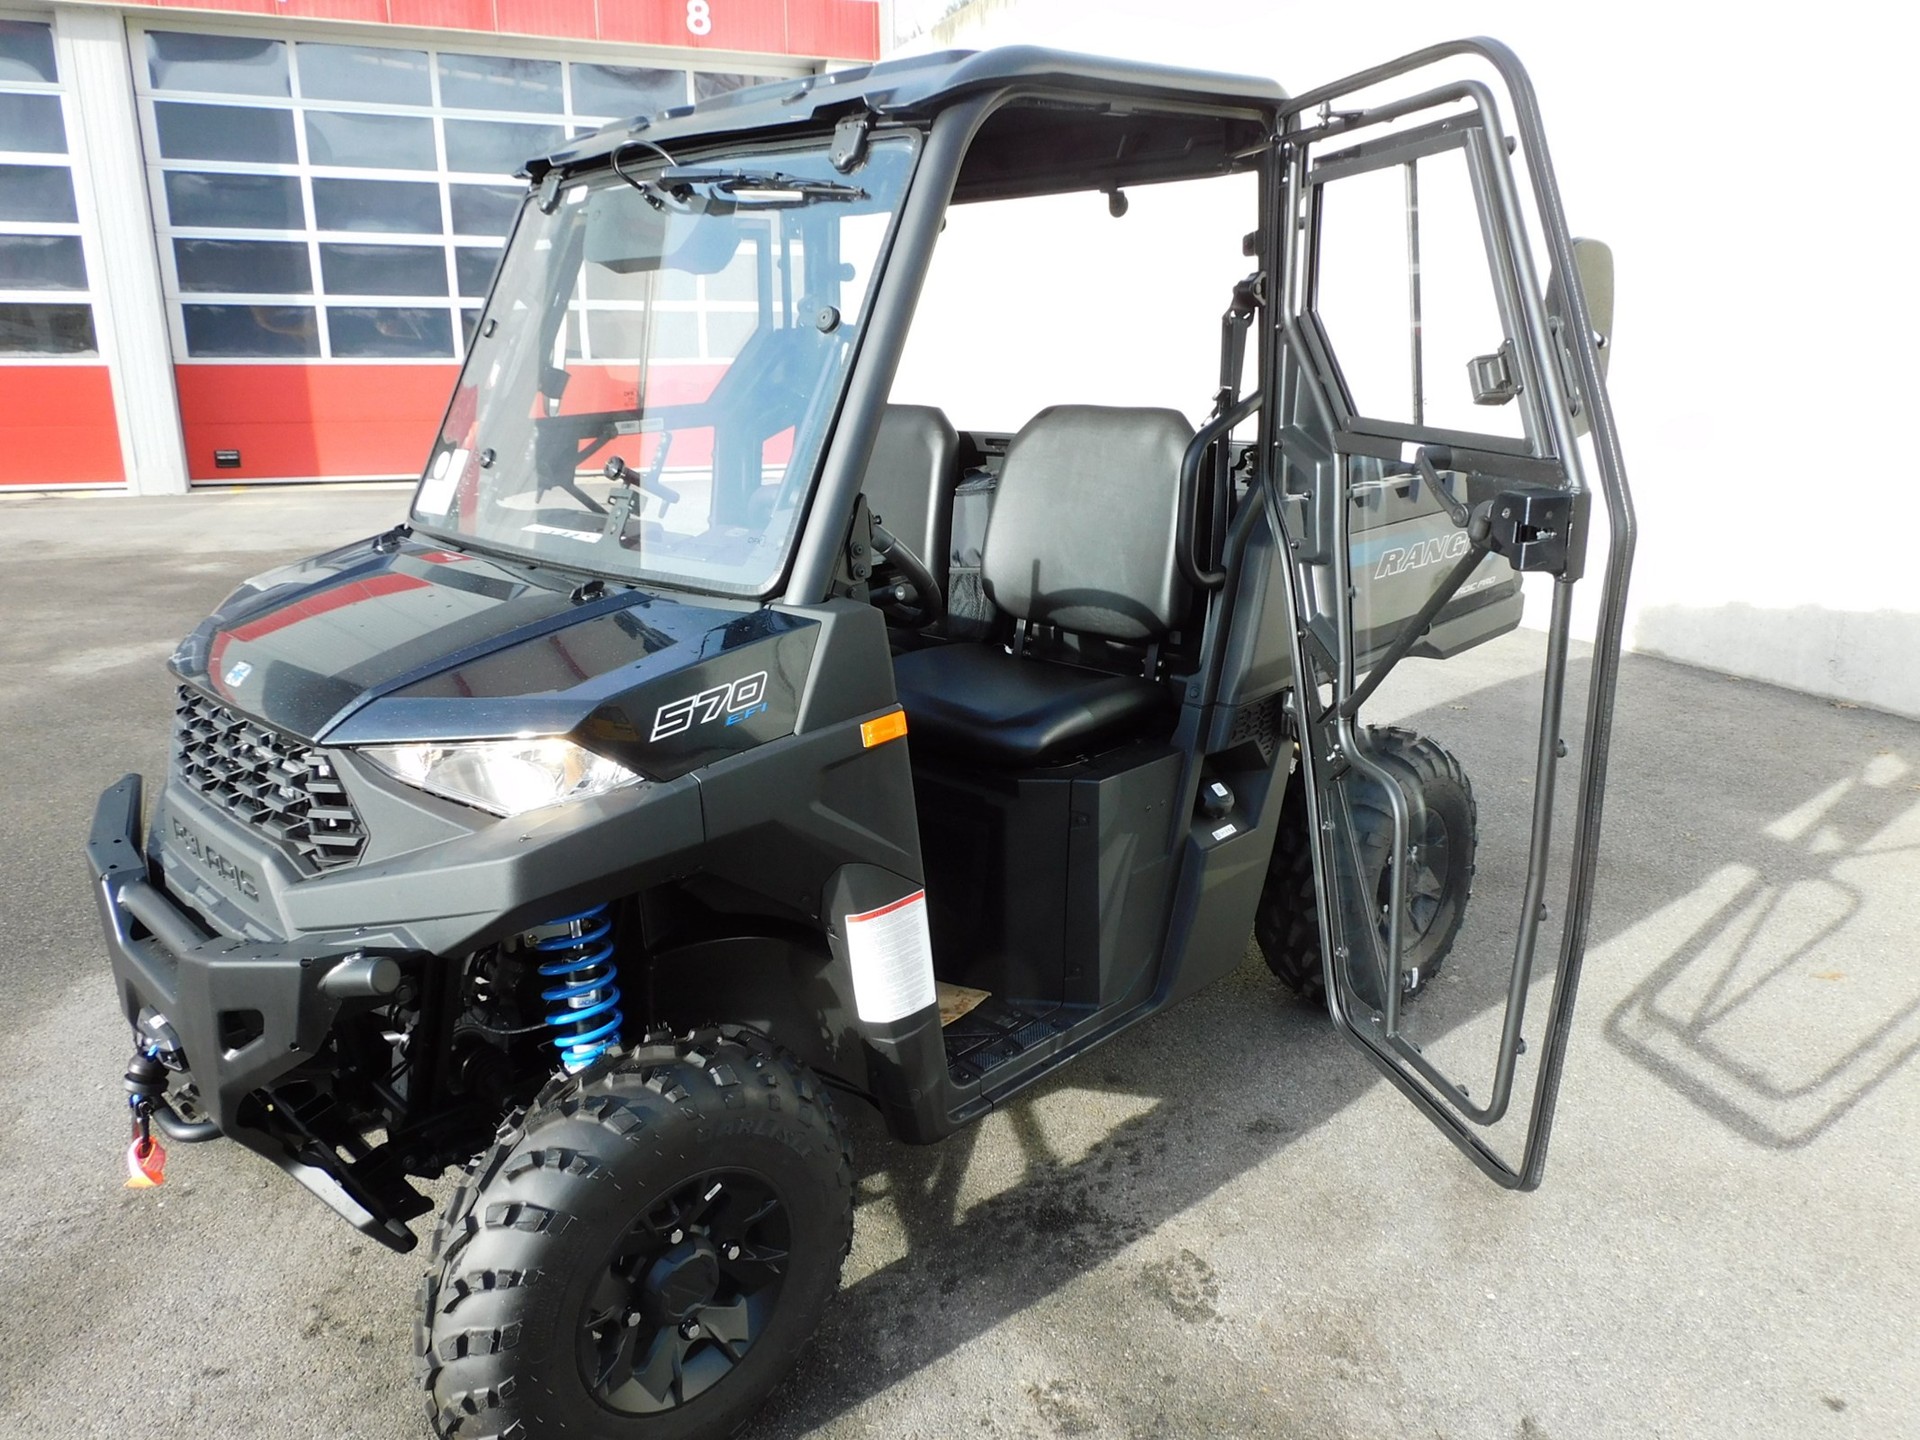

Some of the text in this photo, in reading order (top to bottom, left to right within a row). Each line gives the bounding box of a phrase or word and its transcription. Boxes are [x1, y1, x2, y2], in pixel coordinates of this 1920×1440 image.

[686, 0, 711, 36] 8
[1373, 530, 1473, 580] RANG
[650, 671, 768, 742] 570
[725, 702, 768, 727] EFI
